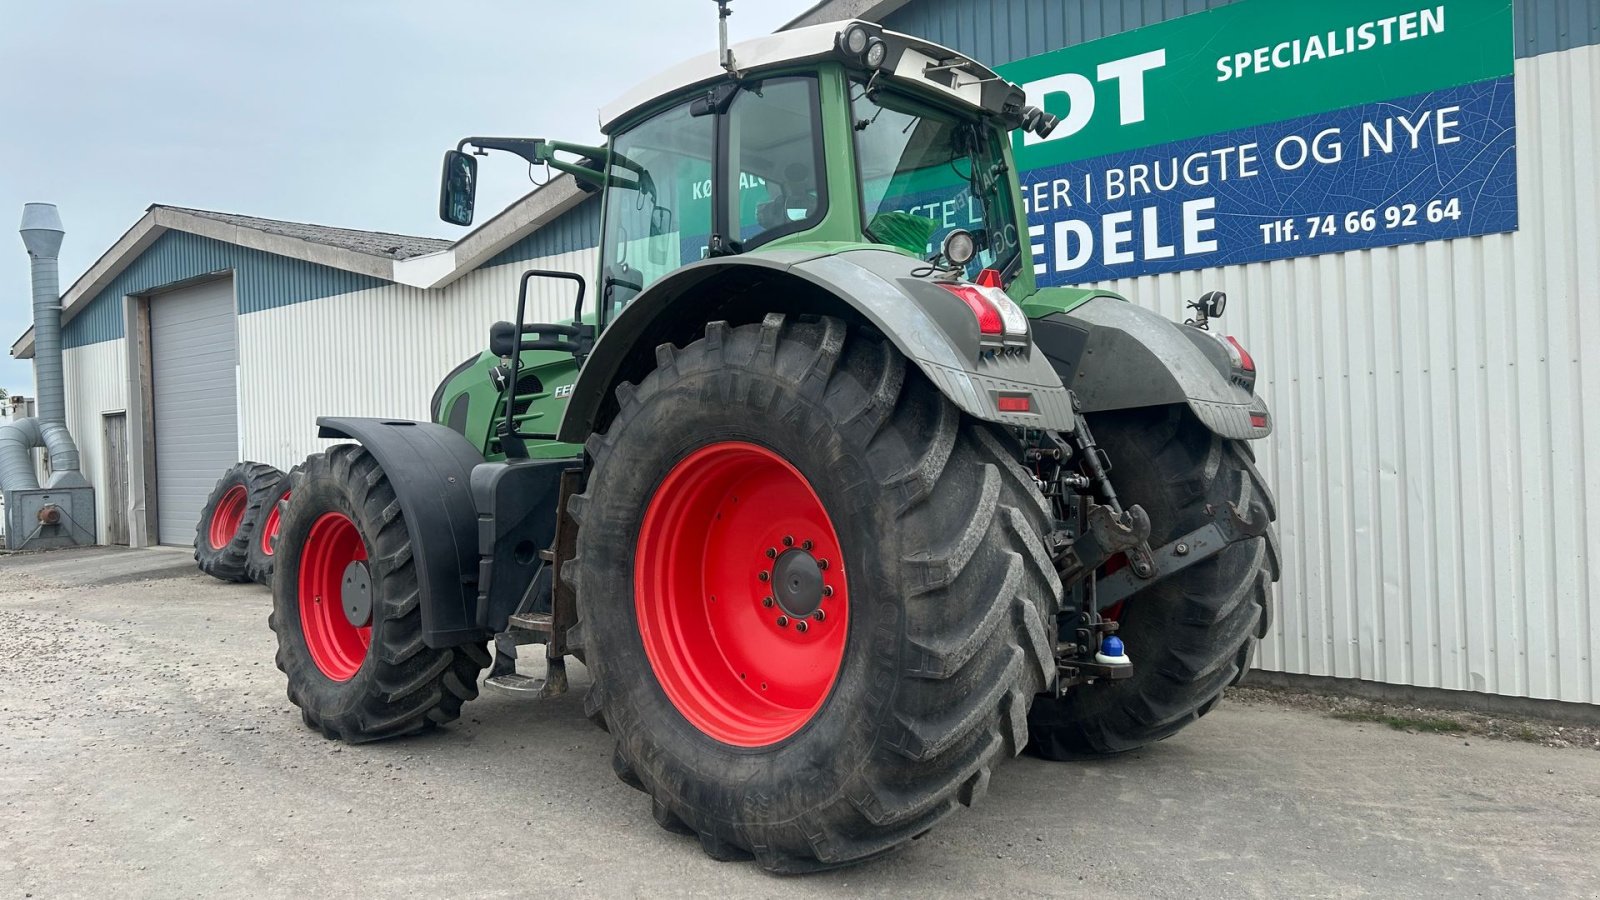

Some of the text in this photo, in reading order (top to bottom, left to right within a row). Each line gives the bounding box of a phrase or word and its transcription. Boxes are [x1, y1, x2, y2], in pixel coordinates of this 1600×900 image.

[1217, 6, 1445, 82] SPECIALISTEN
[1021, 48, 1166, 147] DT
[1085, 173, 1091, 204] I
[1106, 142, 1259, 201] BRUGTE
[1274, 128, 1342, 171] OG
[1362, 105, 1461, 158] NYE
[1259, 197, 1462, 245] Tlf. 74 66 92 64
